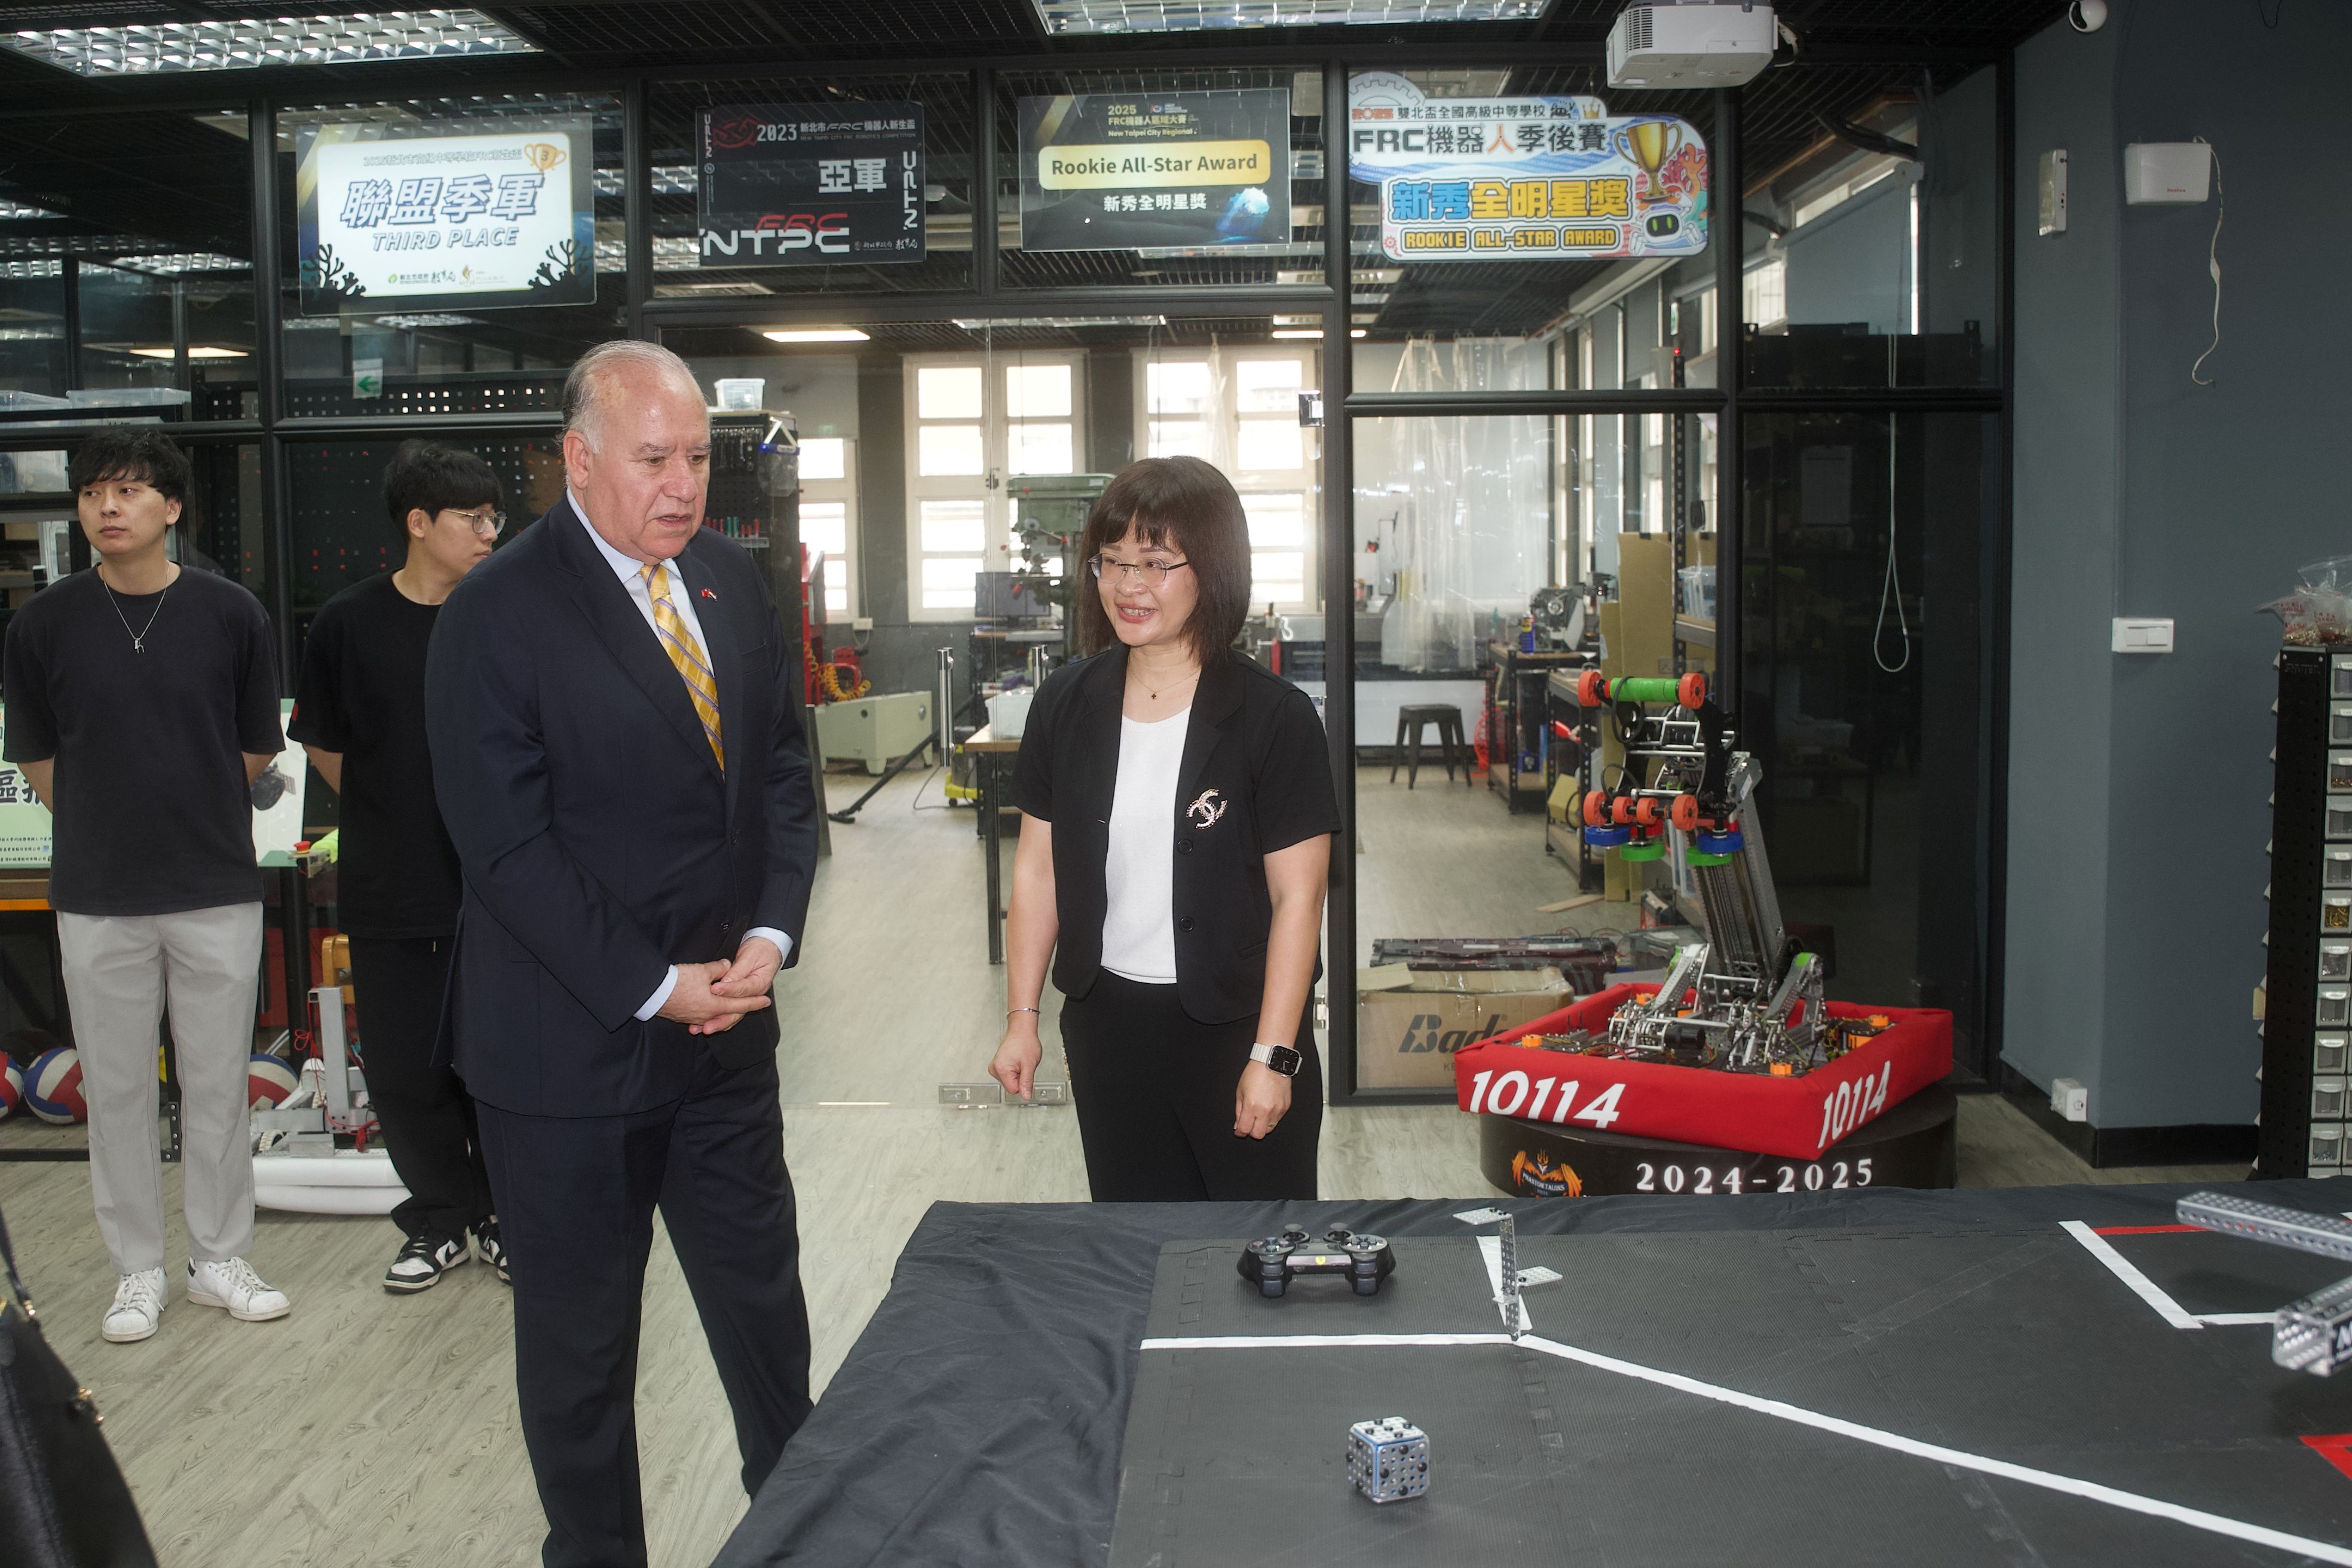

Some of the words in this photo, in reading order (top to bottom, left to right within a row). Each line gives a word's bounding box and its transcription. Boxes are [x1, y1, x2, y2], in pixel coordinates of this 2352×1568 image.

[1108, 105, 1137, 115] 2025
[1398, 105, 1546, 120] 雙北盃全國高級中等學校
[757, 124, 797, 142] 2023
[1147, 129, 1162, 137] City
[1162, 128, 1193, 137] Regional
[1353, 122, 1606, 154] FRC機器人季後賽
[819, 158, 887, 193] 亞軍
[1052, 158, 1116, 175] Rookie
[1122, 156, 1192, 173] All-Star
[1198, 154, 1257, 171] Award
[340, 173, 544, 228] 聯盟季軍
[1104, 192, 1207, 212] 新秀全明星獎
[1392, 180, 1630, 220] 新秀全明星獎
[755, 213, 848, 233] FRC
[373, 230, 440, 252] THIRD
[447, 227, 519, 248] PLACE
[699, 228, 850, 256] NTPC
[1405, 231, 1466, 247] ROOKIE
[1475, 229, 1555, 247] ALL-STAR
[1564, 229, 1615, 246] AWARD
[1398, 1014, 1509, 1054] Bad
[1470, 1070, 1626, 1128] 10114
[1818, 1060, 1891, 1149] 10114
[1636, 1158, 1872, 1195] 2024-2025
